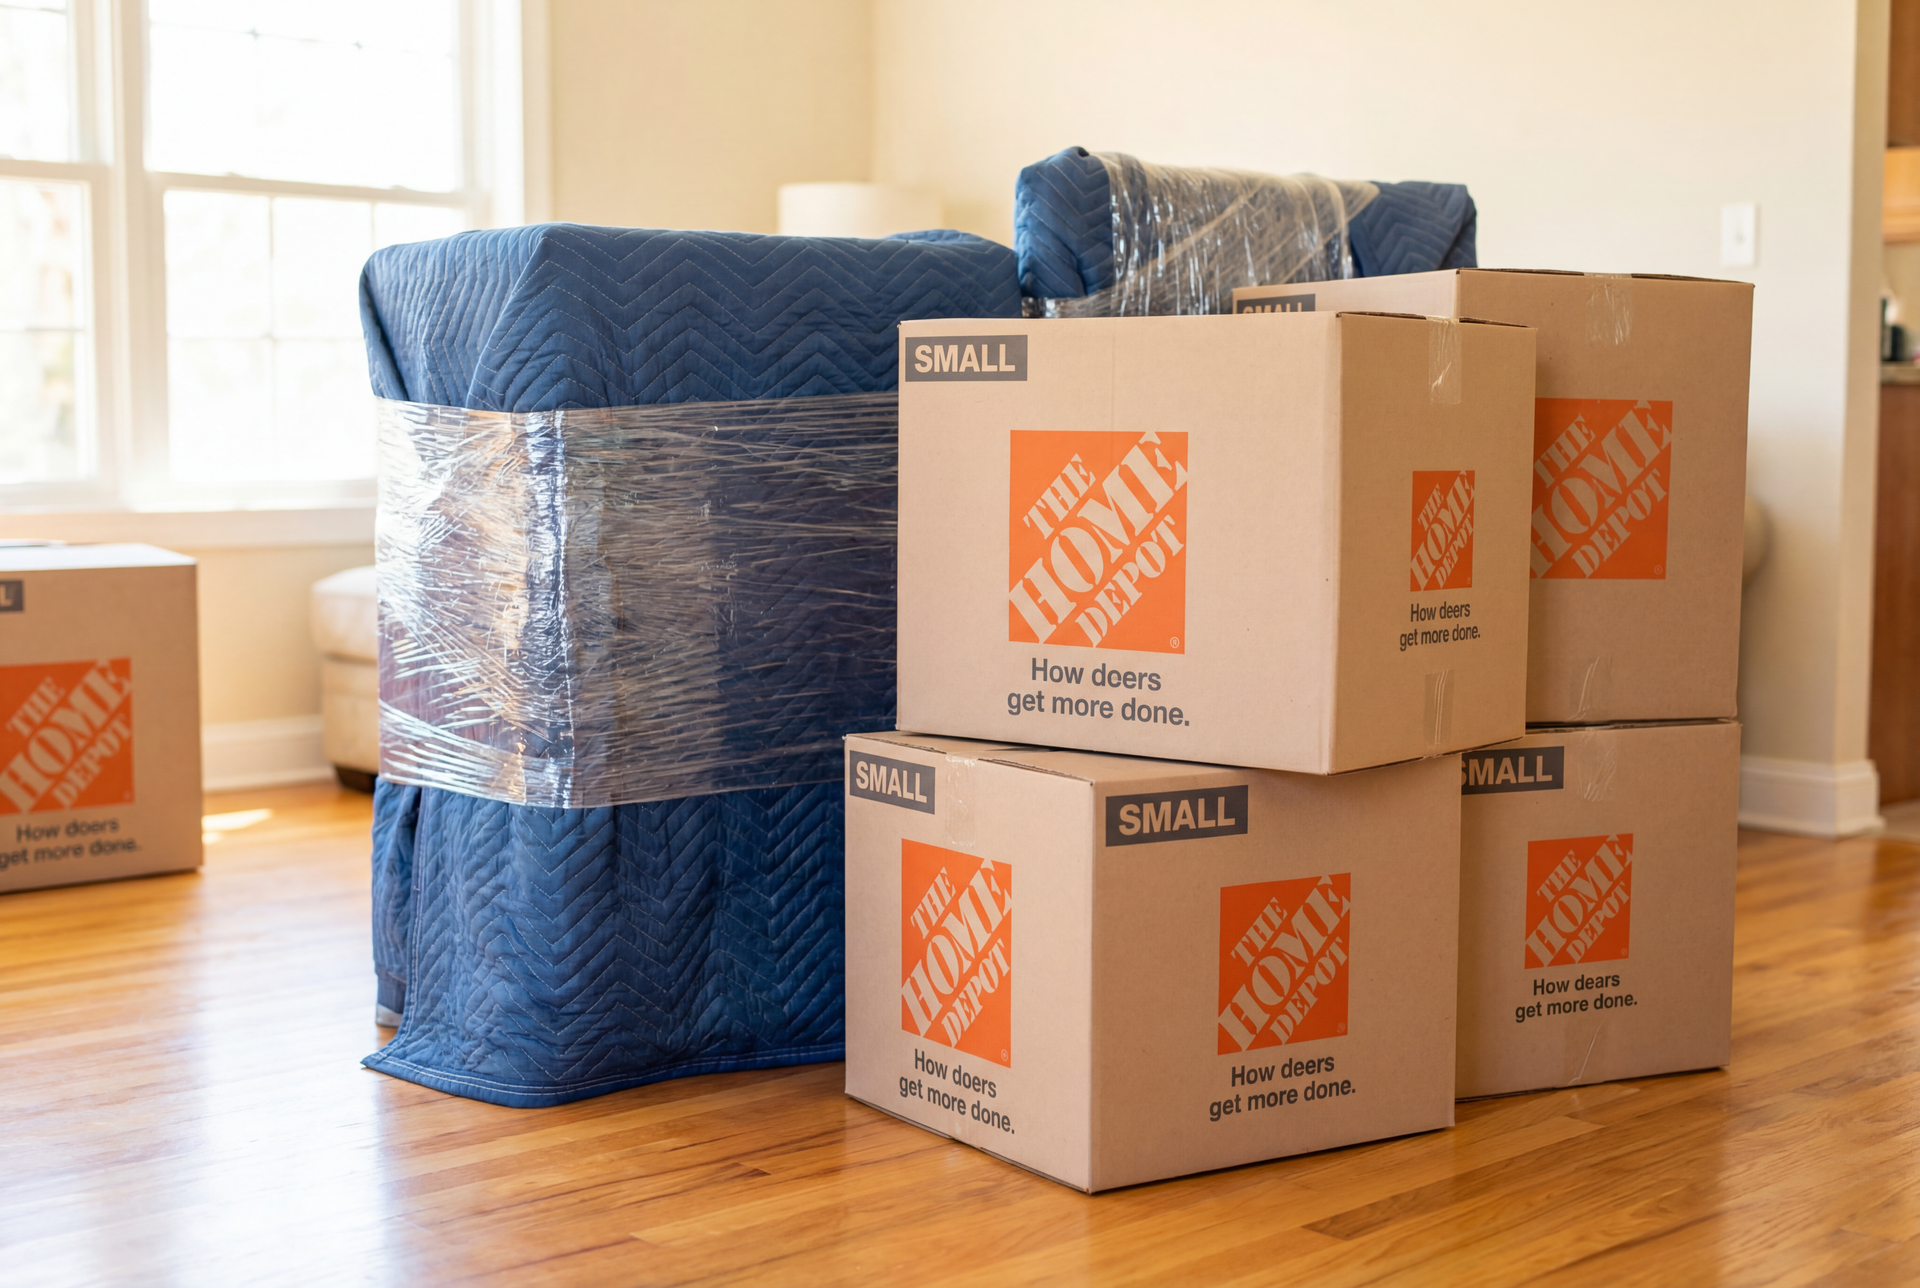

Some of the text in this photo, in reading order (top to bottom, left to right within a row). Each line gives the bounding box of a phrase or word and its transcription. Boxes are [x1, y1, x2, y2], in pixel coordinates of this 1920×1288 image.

[914, 343, 1016, 373] SMALL
[1533, 412, 1597, 489] THE
[1022, 453, 1096, 540] THE
[1417, 483, 1444, 532] THE
[1530, 399, 1673, 579] HOME
[1008, 431, 1189, 644] HOME
[1410, 470, 1475, 591] HOME
[1435, 513, 1474, 589] DEPOT
[1571, 467, 1668, 579] DEPOT
[1074, 514, 1185, 648] DEPOT
[1399, 623, 1481, 652] get more done.
[1410, 603, 1437, 623] How
[1031, 657, 1084, 685] How
[0, 659, 133, 814] HOME
[6, 677, 66, 738] THE
[1007, 690, 1190, 727] get more done.
[52, 713, 132, 810] DEPOT
[856, 761, 928, 803] SMALL
[1461, 755, 1553, 787] MALL
[15, 823, 61, 844] How
[1118, 796, 1236, 836] SMALL
[0, 847, 30, 872] get
[33, 842, 85, 863] more
[1537, 849, 1582, 903] THE
[910, 866, 957, 940] THE
[1525, 834, 1633, 967] HOME
[1566, 880, 1630, 964] DEPOT
[901, 859, 1013, 1037] HOME
[1230, 897, 1288, 968] THE
[941, 938, 1011, 1049] DEPOT
[1218, 875, 1351, 1052] HOME
[1269, 936, 1348, 1045] DEPOT
[1533, 978, 1570, 996] How
[1515, 993, 1638, 1023] get more done.
[914, 1048, 997, 1099] How doers
[1209, 1079, 1356, 1122] get more done.
[1231, 1065, 1276, 1087] How
[899, 1076, 1015, 1135] get more done.
